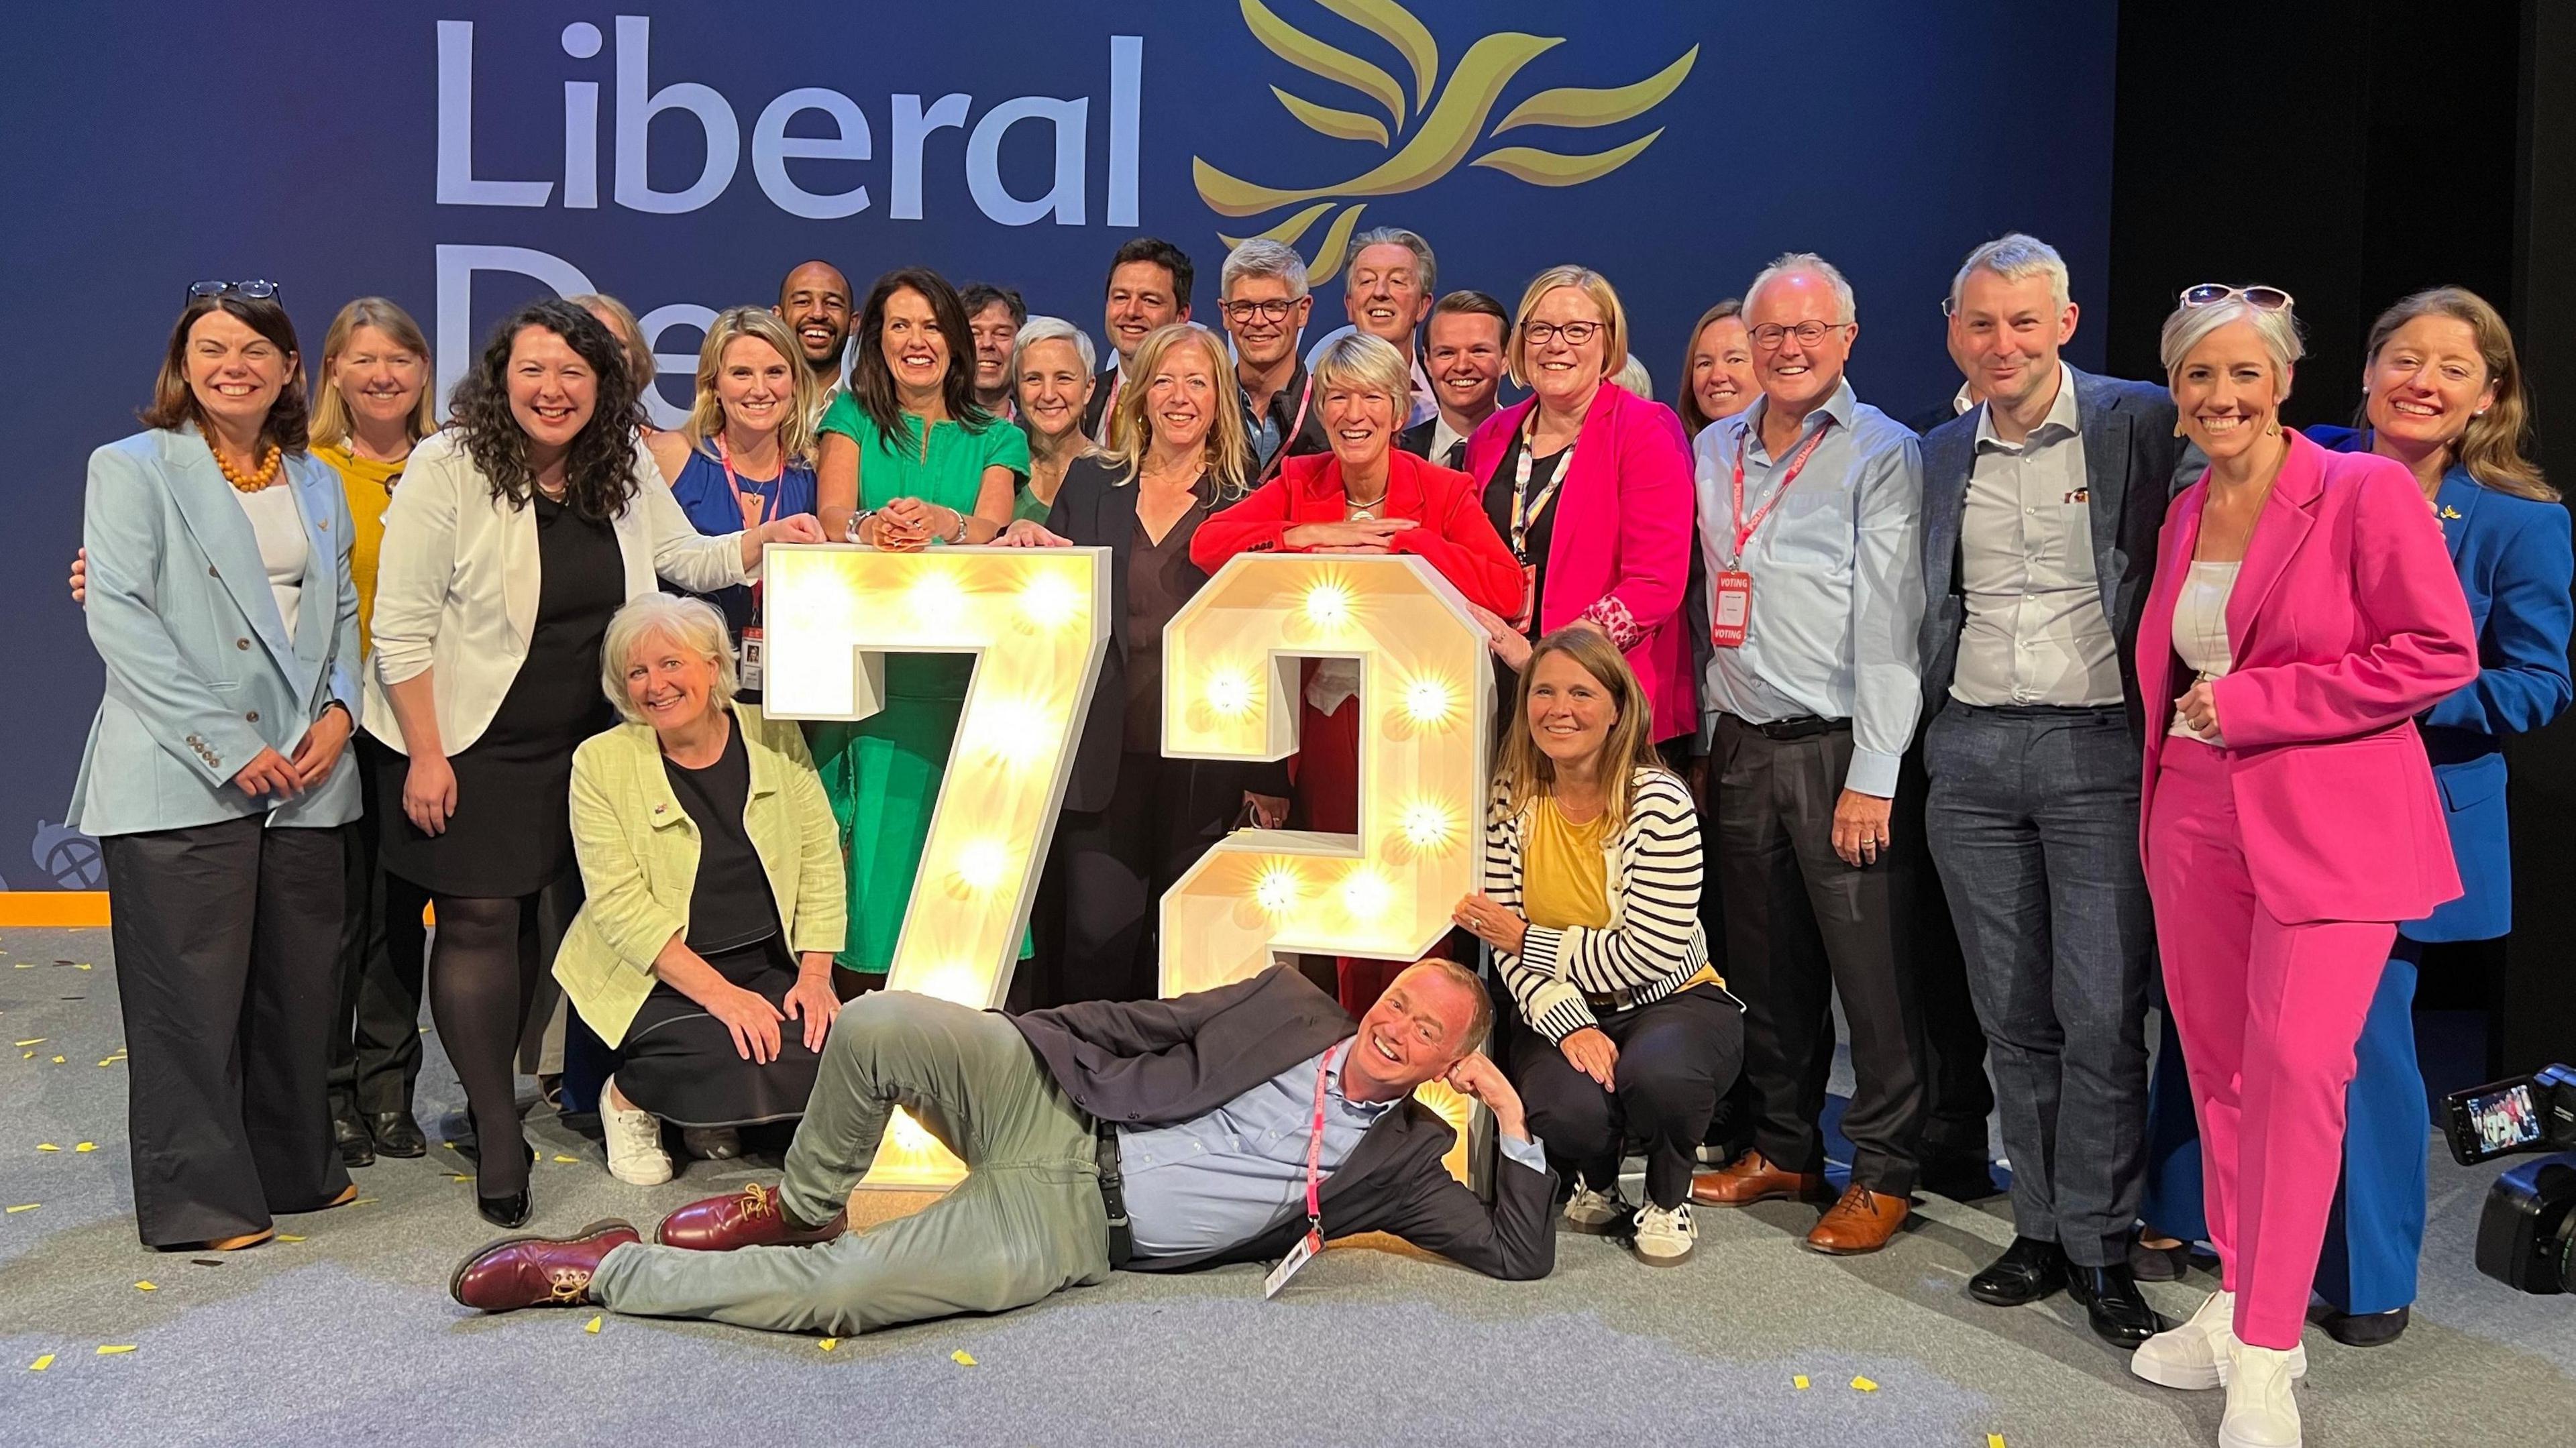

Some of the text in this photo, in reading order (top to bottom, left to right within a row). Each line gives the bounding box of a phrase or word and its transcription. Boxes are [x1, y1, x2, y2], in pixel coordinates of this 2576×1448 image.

[437, 15, 1143, 227] Liberal
[1715, 629, 1741, 639] VOTING
[1721, 577, 1748, 588] VOTING
[763, 545, 1497, 1197] 72
